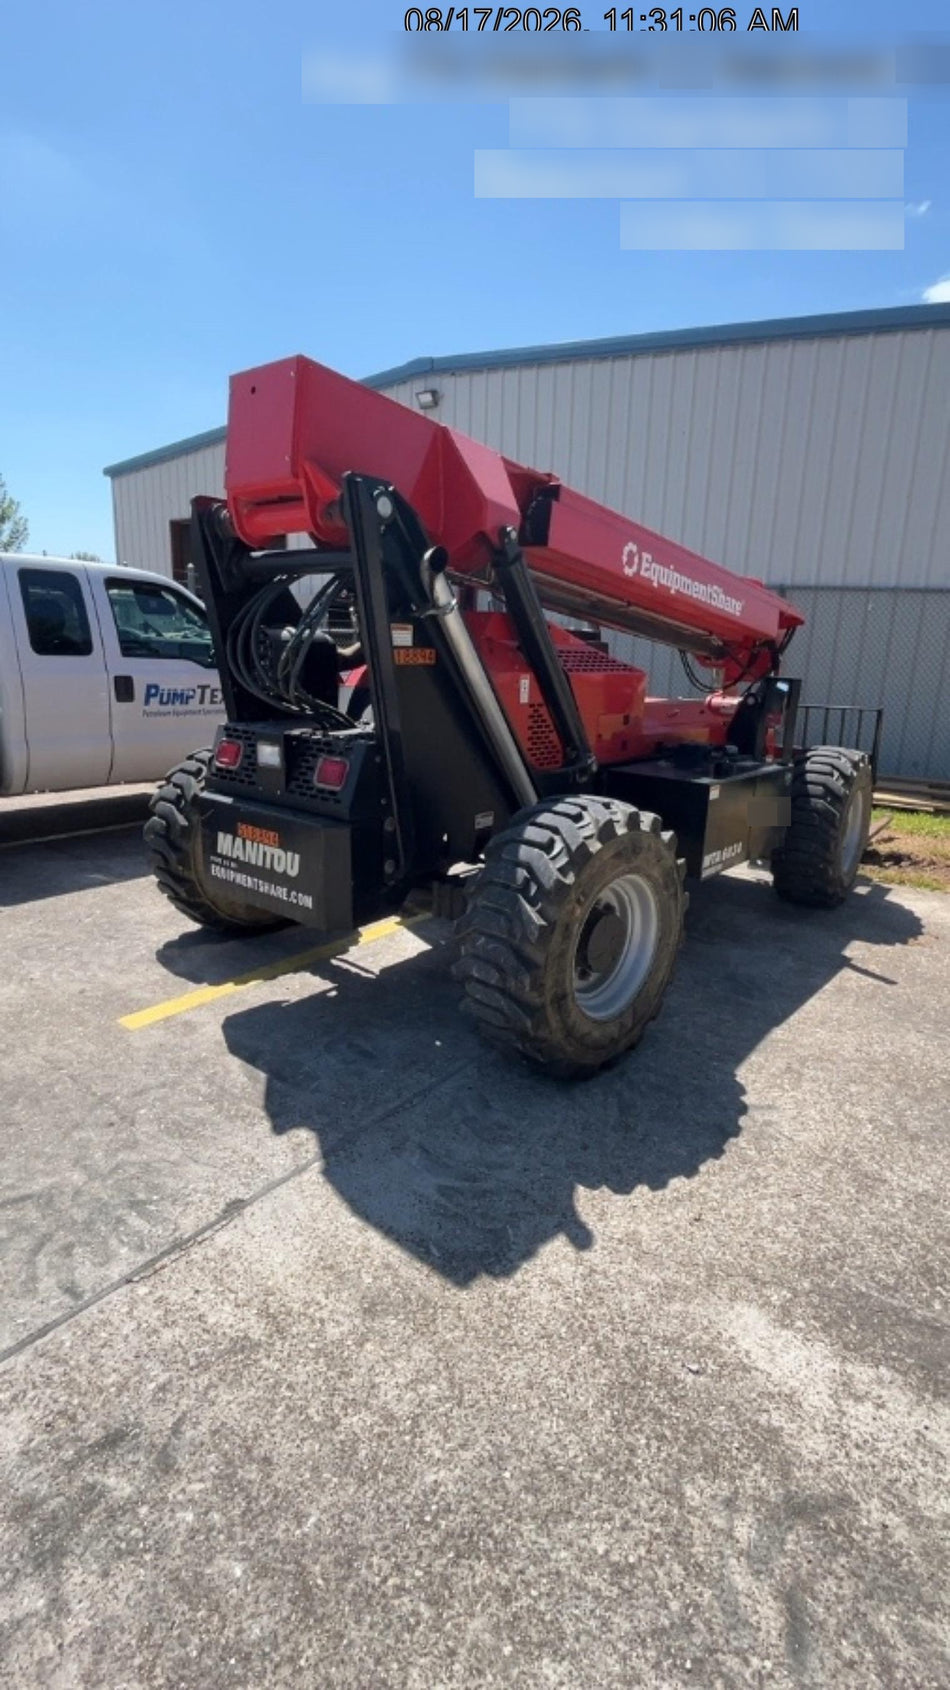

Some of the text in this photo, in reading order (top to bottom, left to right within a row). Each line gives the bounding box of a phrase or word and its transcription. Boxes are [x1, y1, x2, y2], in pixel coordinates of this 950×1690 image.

[640, 552, 743, 616] EquipmentShare
[217, 831, 300, 877] MANITOU
[211, 864, 313, 909] EQUIPMENTSHARE.COM
